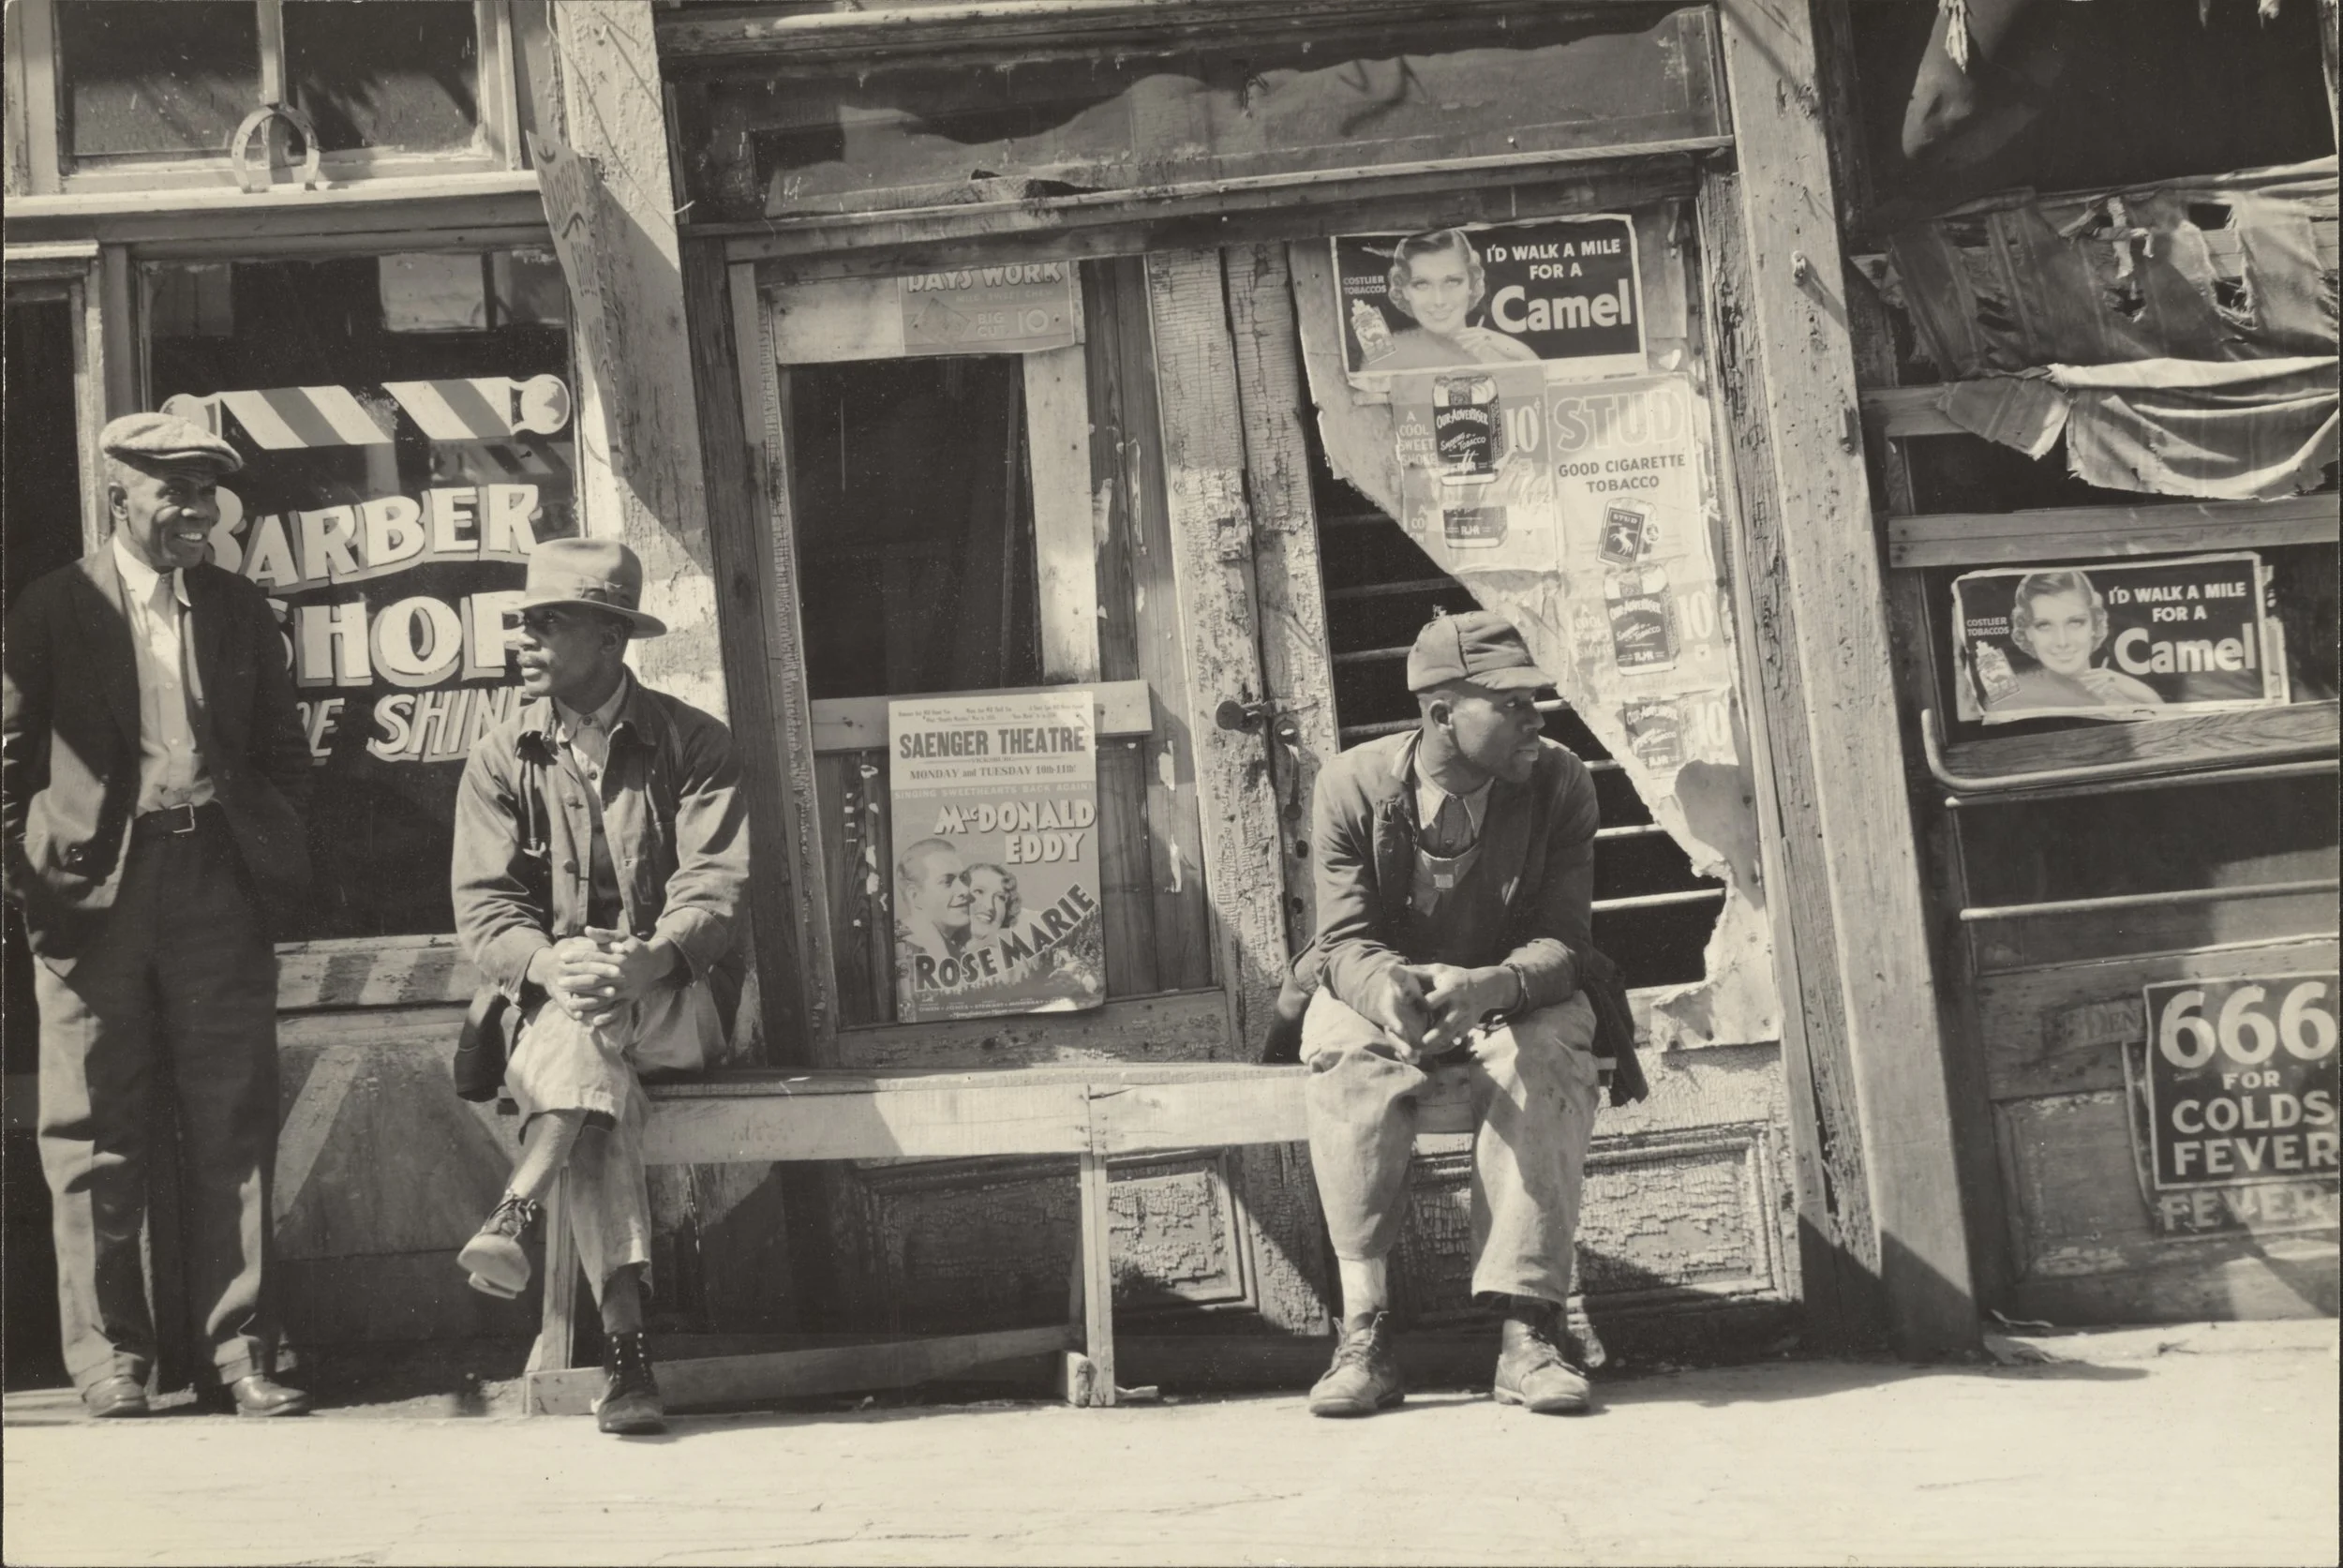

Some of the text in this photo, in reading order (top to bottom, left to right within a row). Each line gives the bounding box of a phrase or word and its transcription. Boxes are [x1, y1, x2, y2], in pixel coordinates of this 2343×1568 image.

[1486, 238, 1621, 263] I'D WALK A MILE
[981, 261, 1063, 288] WORK
[1342, 275, 1386, 287] COSTLIER
[1530, 262, 1583, 280] FOR A
[1343, 284, 1387, 295] TOBACCOS
[1490, 278, 1632, 334] Camel
[977, 311, 1006, 325] BIG
[1406, 411, 1417, 422] A
[1553, 387, 1686, 453] STUD
[1399, 424, 1429, 437] COOL
[1399, 439, 1435, 451] SWEET
[1559, 454, 1686, 478] GOOD CIGARETTE
[1586, 475, 1660, 494] TOBACCO
[1613, 514, 1638, 524] STUD
[2109, 581, 2246, 605] I'D WALK A MILE
[1966, 616, 2007, 628] COSTLIER
[2152, 605, 2208, 623] FOR A
[266, 590, 528, 688] HOP
[1966, 625, 2010, 636] TOBACCOS
[2112, 622, 2256, 676] Camel
[899, 726, 1086, 759] SAENGER THEATRE
[910, 767, 960, 781] MONDAY
[963, 767, 977, 778] and
[980, 765, 1032, 778] TUESDAY
[893, 789, 937, 799] SINGING
[941, 786, 1018, 797] SWEETHEARTS
[1023, 784, 1051, 794] BACK
[1004, 832, 1085, 865] EDDY
[914, 883, 1099, 992] ROSE MARIE
[2158, 981, 2337, 1068] 666
[2222, 1070, 2281, 1090] FOR
[2171, 1090, 2336, 1134] COLDS
[2173, 1132, 2339, 1175] FEVER
[2157, 1183, 2327, 1232] FEVER
